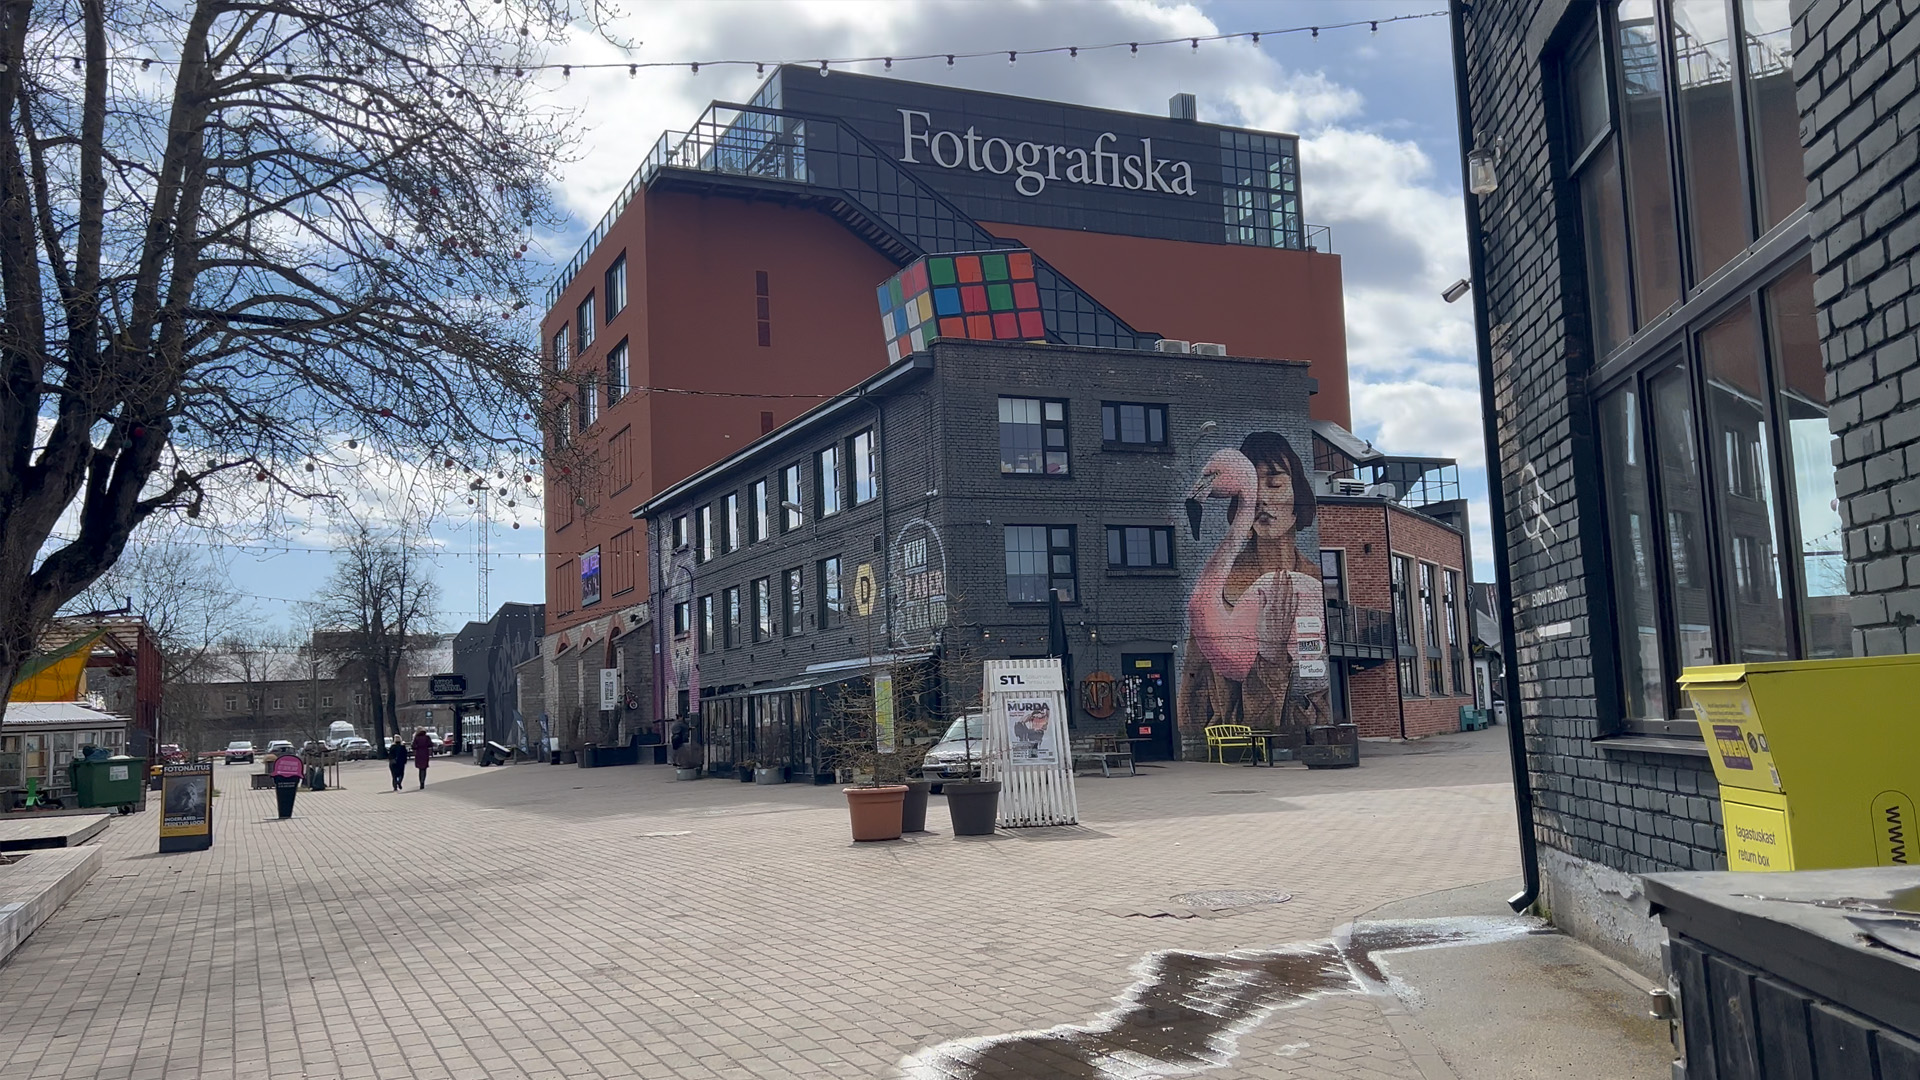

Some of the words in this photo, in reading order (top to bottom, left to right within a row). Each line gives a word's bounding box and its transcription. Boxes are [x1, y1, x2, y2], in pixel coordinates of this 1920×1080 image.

[897, 108, 1196, 196] Fotografiska
[904, 538, 926, 568] KIVI
[860, 576, 870, 604] D
[905, 570, 944, 601] PABER
[1000, 675, 1025, 685] STL
[1008, 702, 1050, 711] MURDA
[1081, 680, 1126, 709] KPK
[1735, 824, 1777, 846] tagastuskast
[1738, 848, 1757, 864] return
[1757, 851, 1771, 867] box
